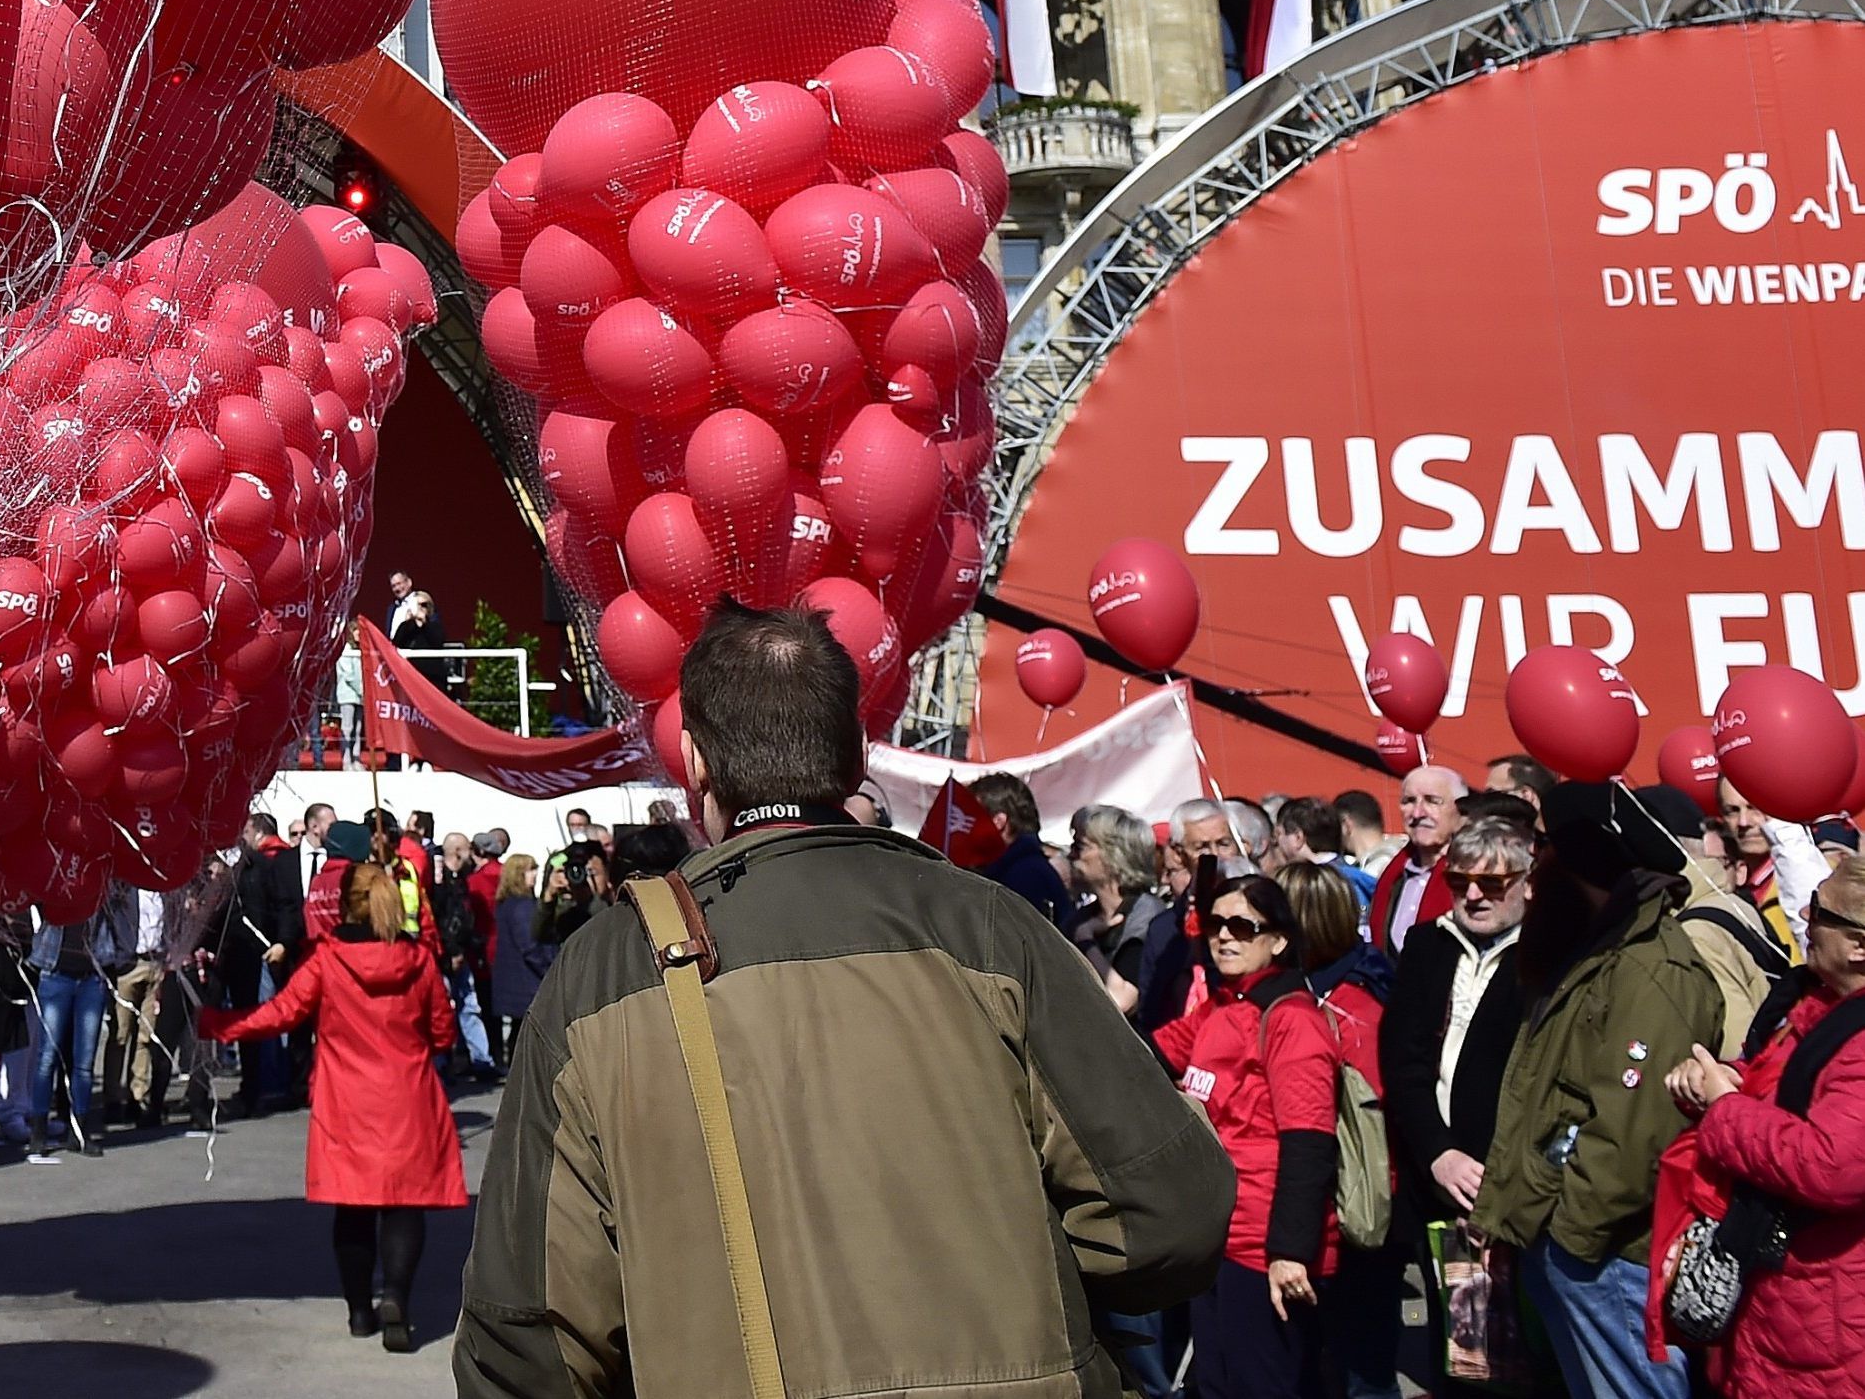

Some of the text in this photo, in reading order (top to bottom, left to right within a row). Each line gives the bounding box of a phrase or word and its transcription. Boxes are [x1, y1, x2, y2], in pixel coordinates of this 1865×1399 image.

[1596, 152, 1777, 237] SPÖ
[667, 204, 692, 238] SPÖ
[840, 247, 862, 286] SPÖ
[1601, 266, 1678, 307] DIE
[68, 306, 113, 333] SPÖ
[1179, 429, 1865, 558] ZUSAMM
[1327, 593, 1649, 719] WIR
[734, 804, 801, 827] Canon
